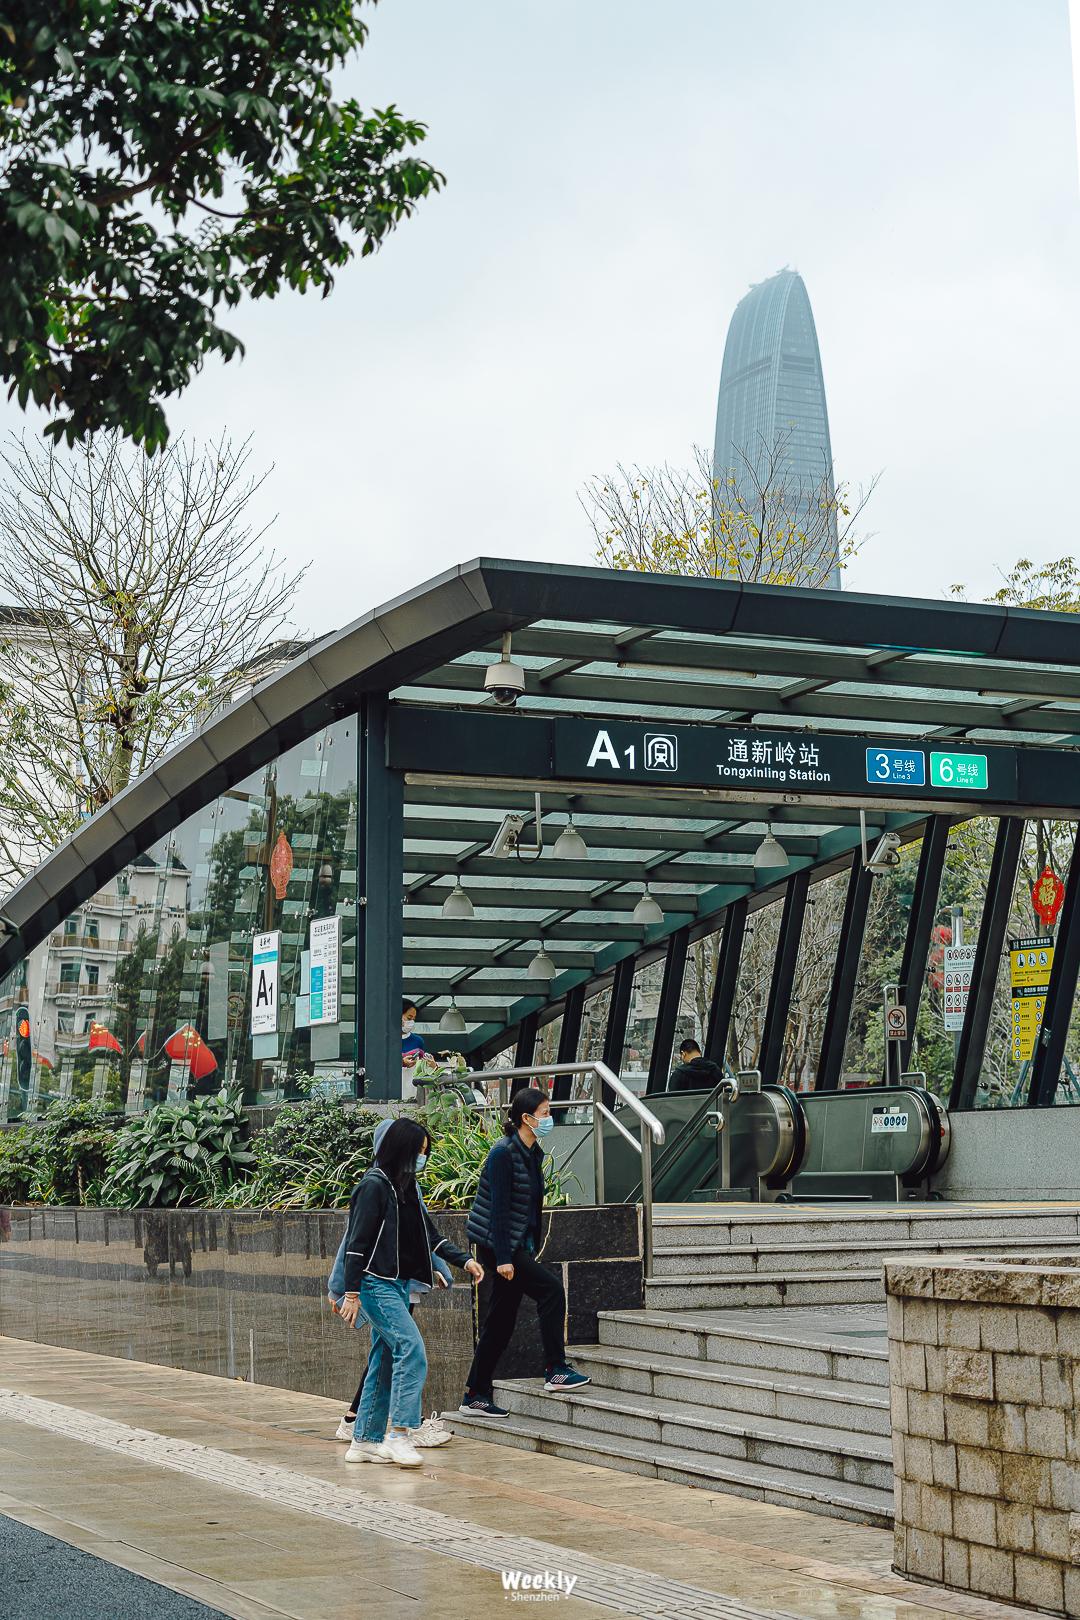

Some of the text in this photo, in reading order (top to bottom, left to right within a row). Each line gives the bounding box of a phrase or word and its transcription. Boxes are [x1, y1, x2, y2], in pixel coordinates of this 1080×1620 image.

[727, 738, 820, 767] 通新岭站
[716, 764, 831, 782] Tongxinling Station
[892, 772, 906, 780] Line
[956, 776, 969, 784] Line
[256, 969, 273, 1007] A1
